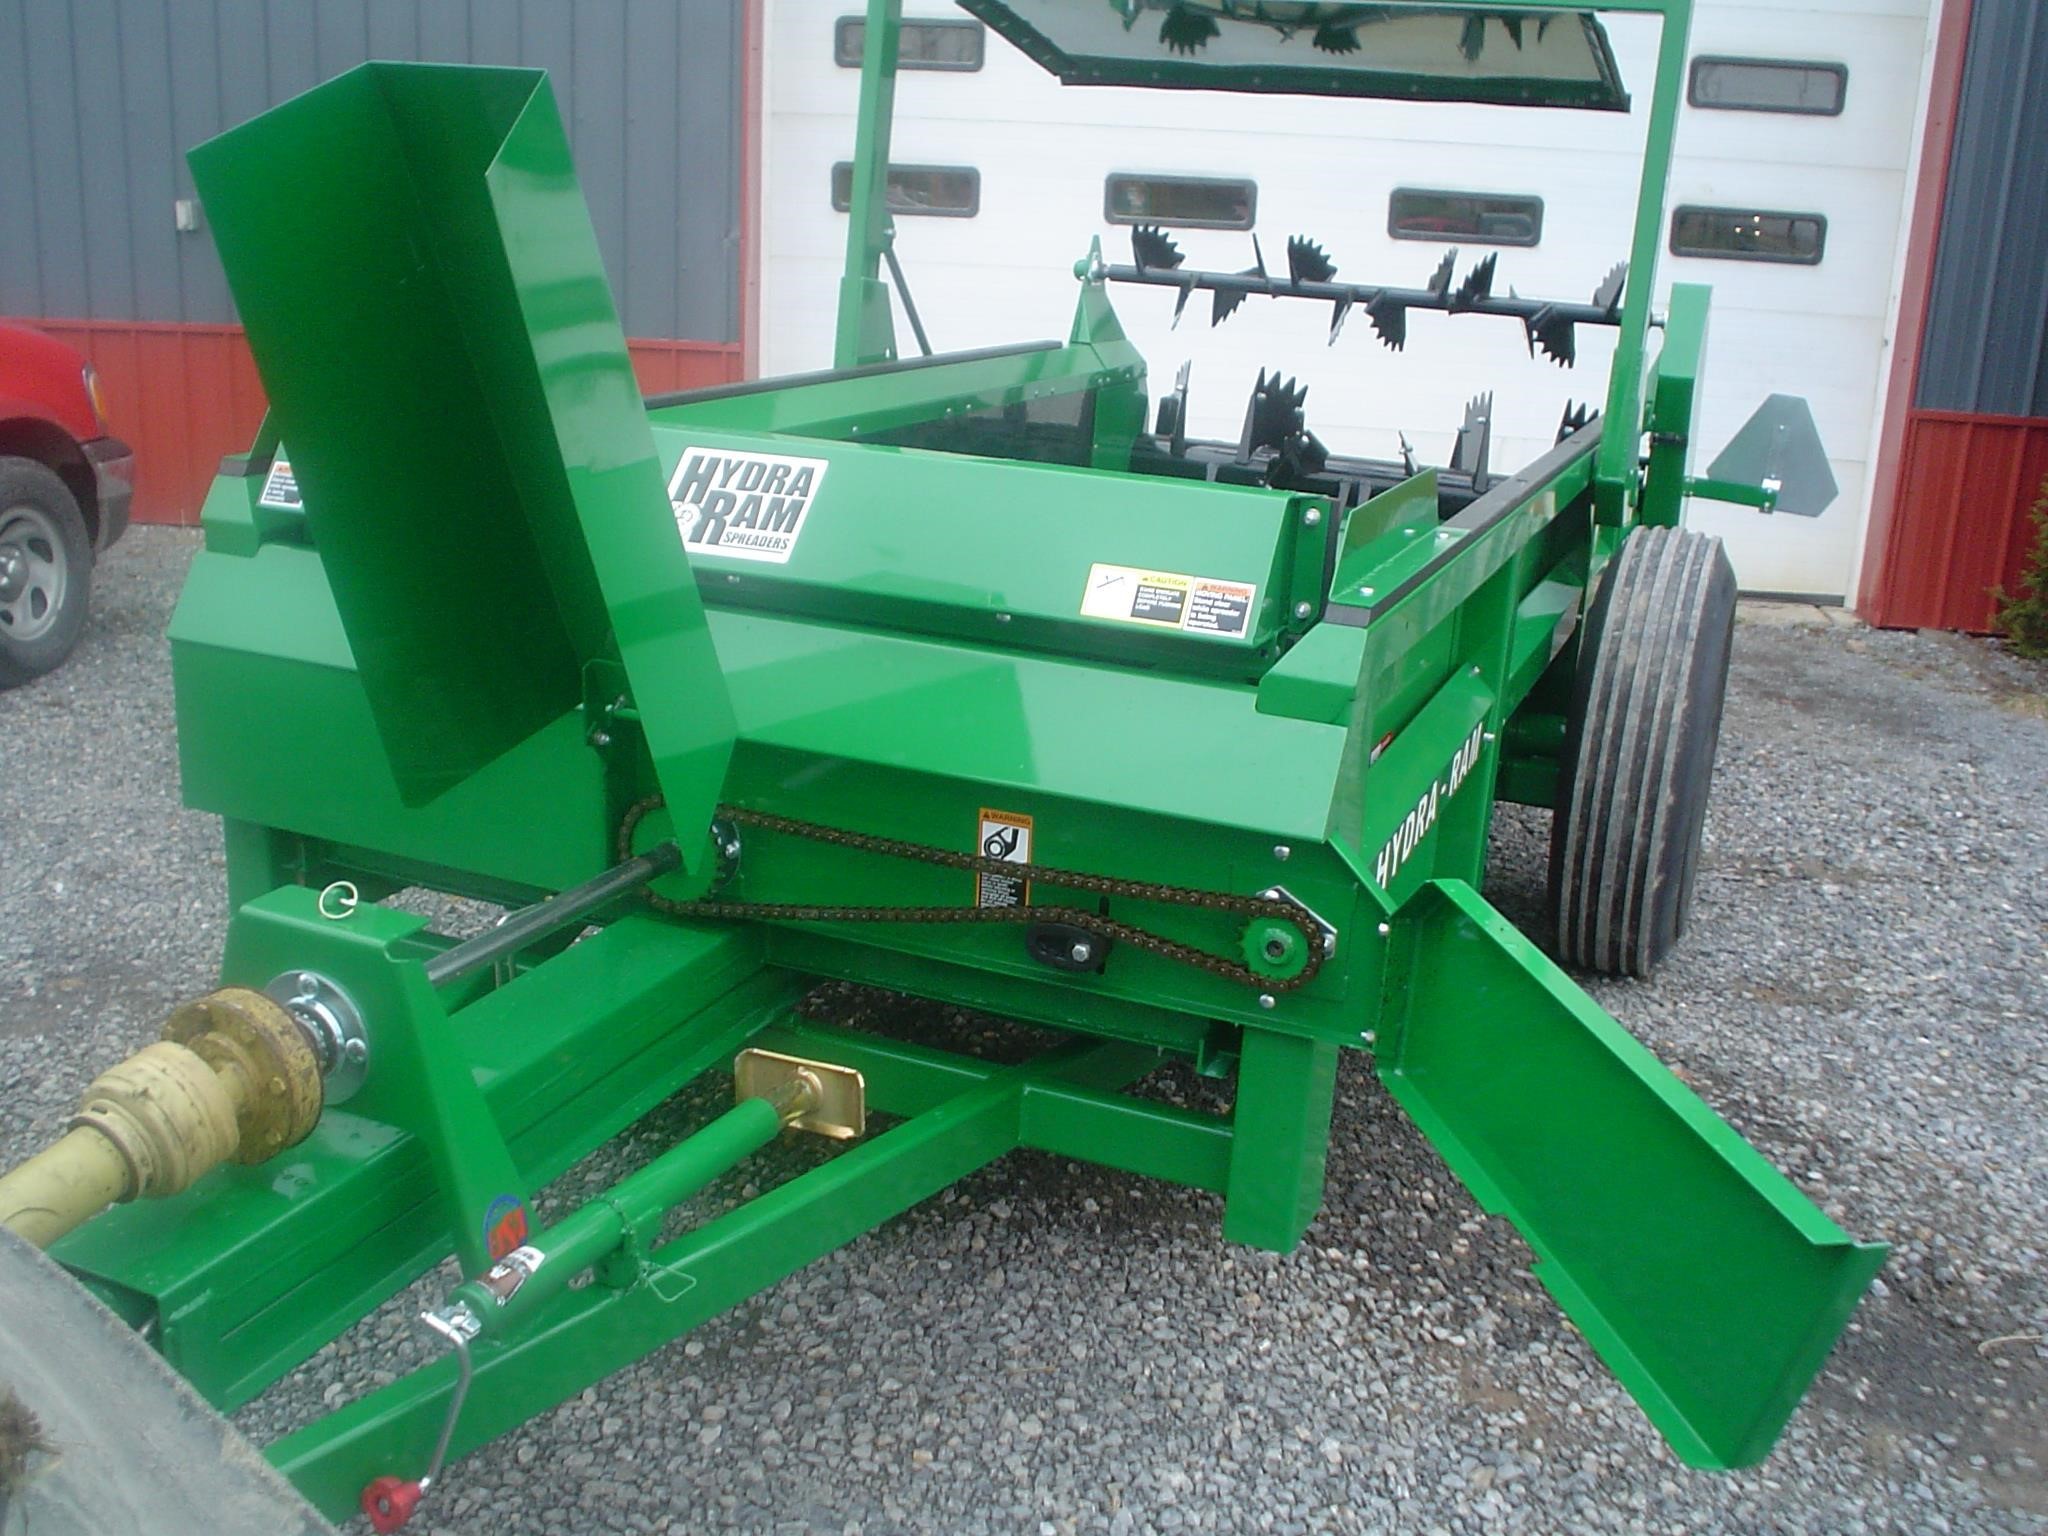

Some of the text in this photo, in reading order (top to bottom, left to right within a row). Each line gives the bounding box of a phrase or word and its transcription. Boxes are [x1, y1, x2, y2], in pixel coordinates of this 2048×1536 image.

[671, 455, 815, 504] HYDRA
[688, 489, 806, 546] RAM
[723, 531, 790, 550] SPREADERS
[1149, 575, 1188, 587] CAUTION
[991, 811, 1031, 825] WARNING
